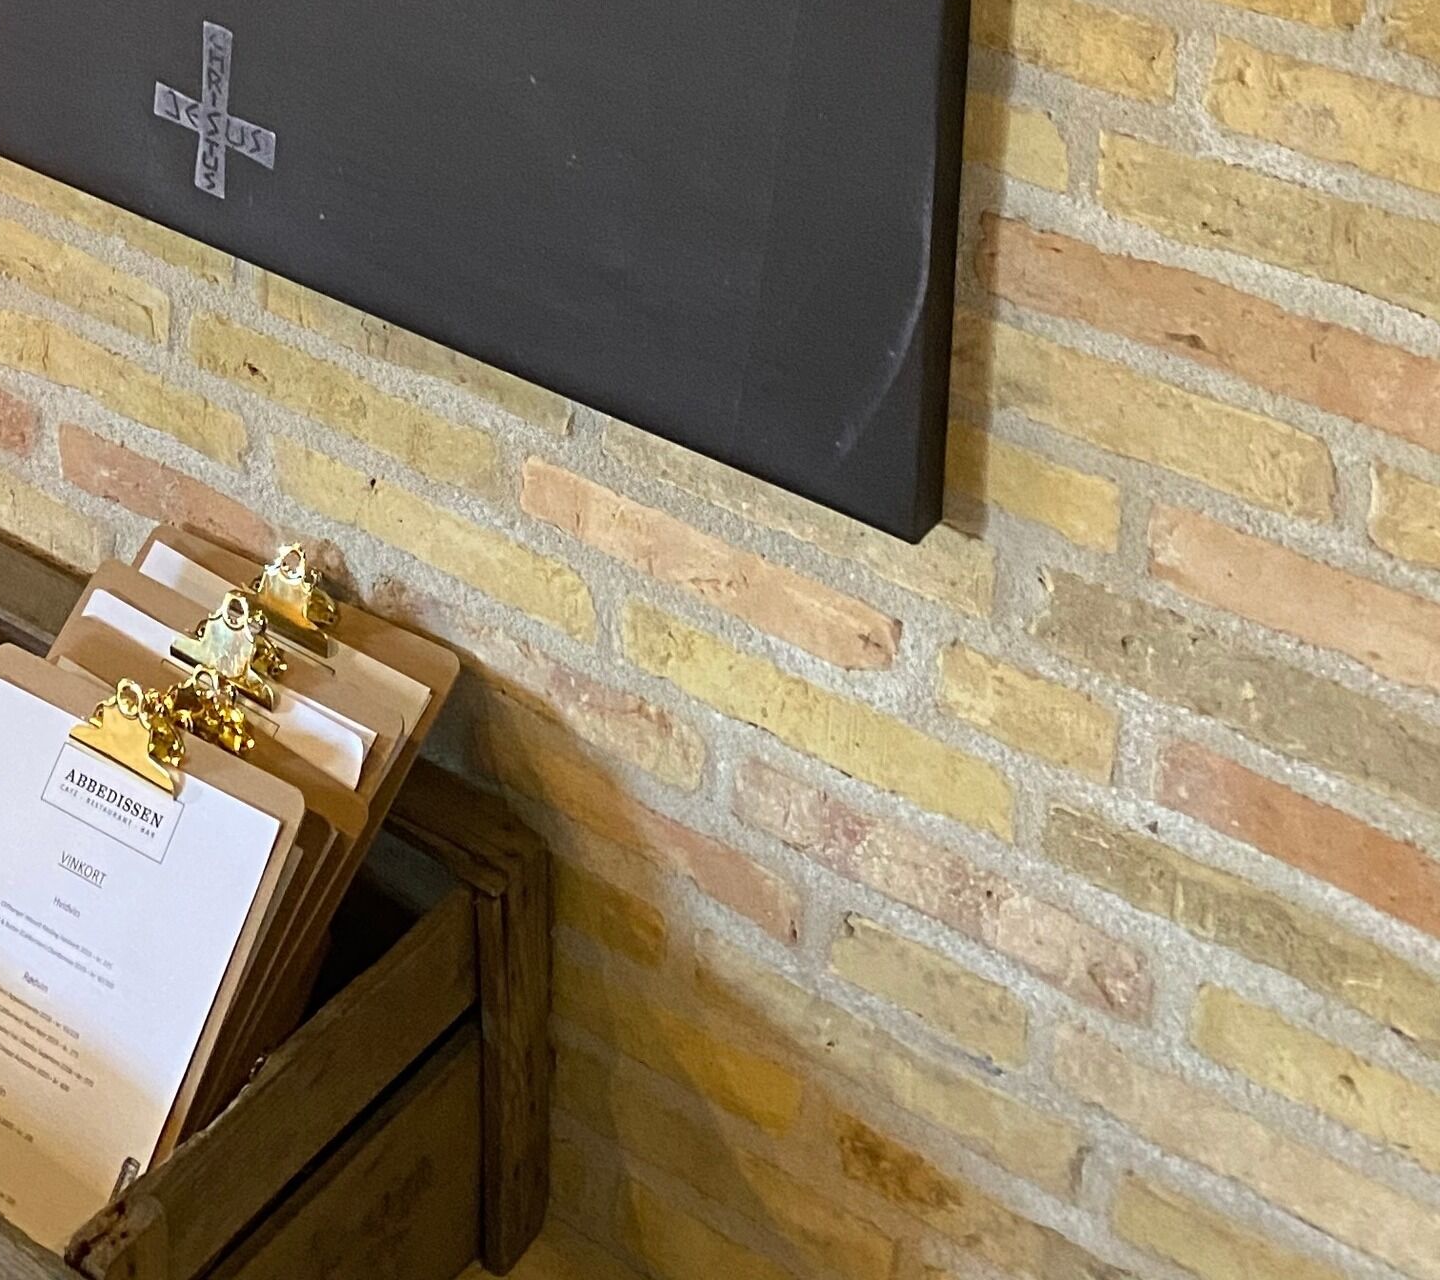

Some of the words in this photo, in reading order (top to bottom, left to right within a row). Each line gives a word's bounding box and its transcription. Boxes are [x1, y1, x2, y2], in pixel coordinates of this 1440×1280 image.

[65, 768, 164, 829] ABBEDISSEN
[86, 797, 133, 828] RESTAURANT
[140, 827, 156, 839] BAR
[60, 851, 108, 886] VINKORT
